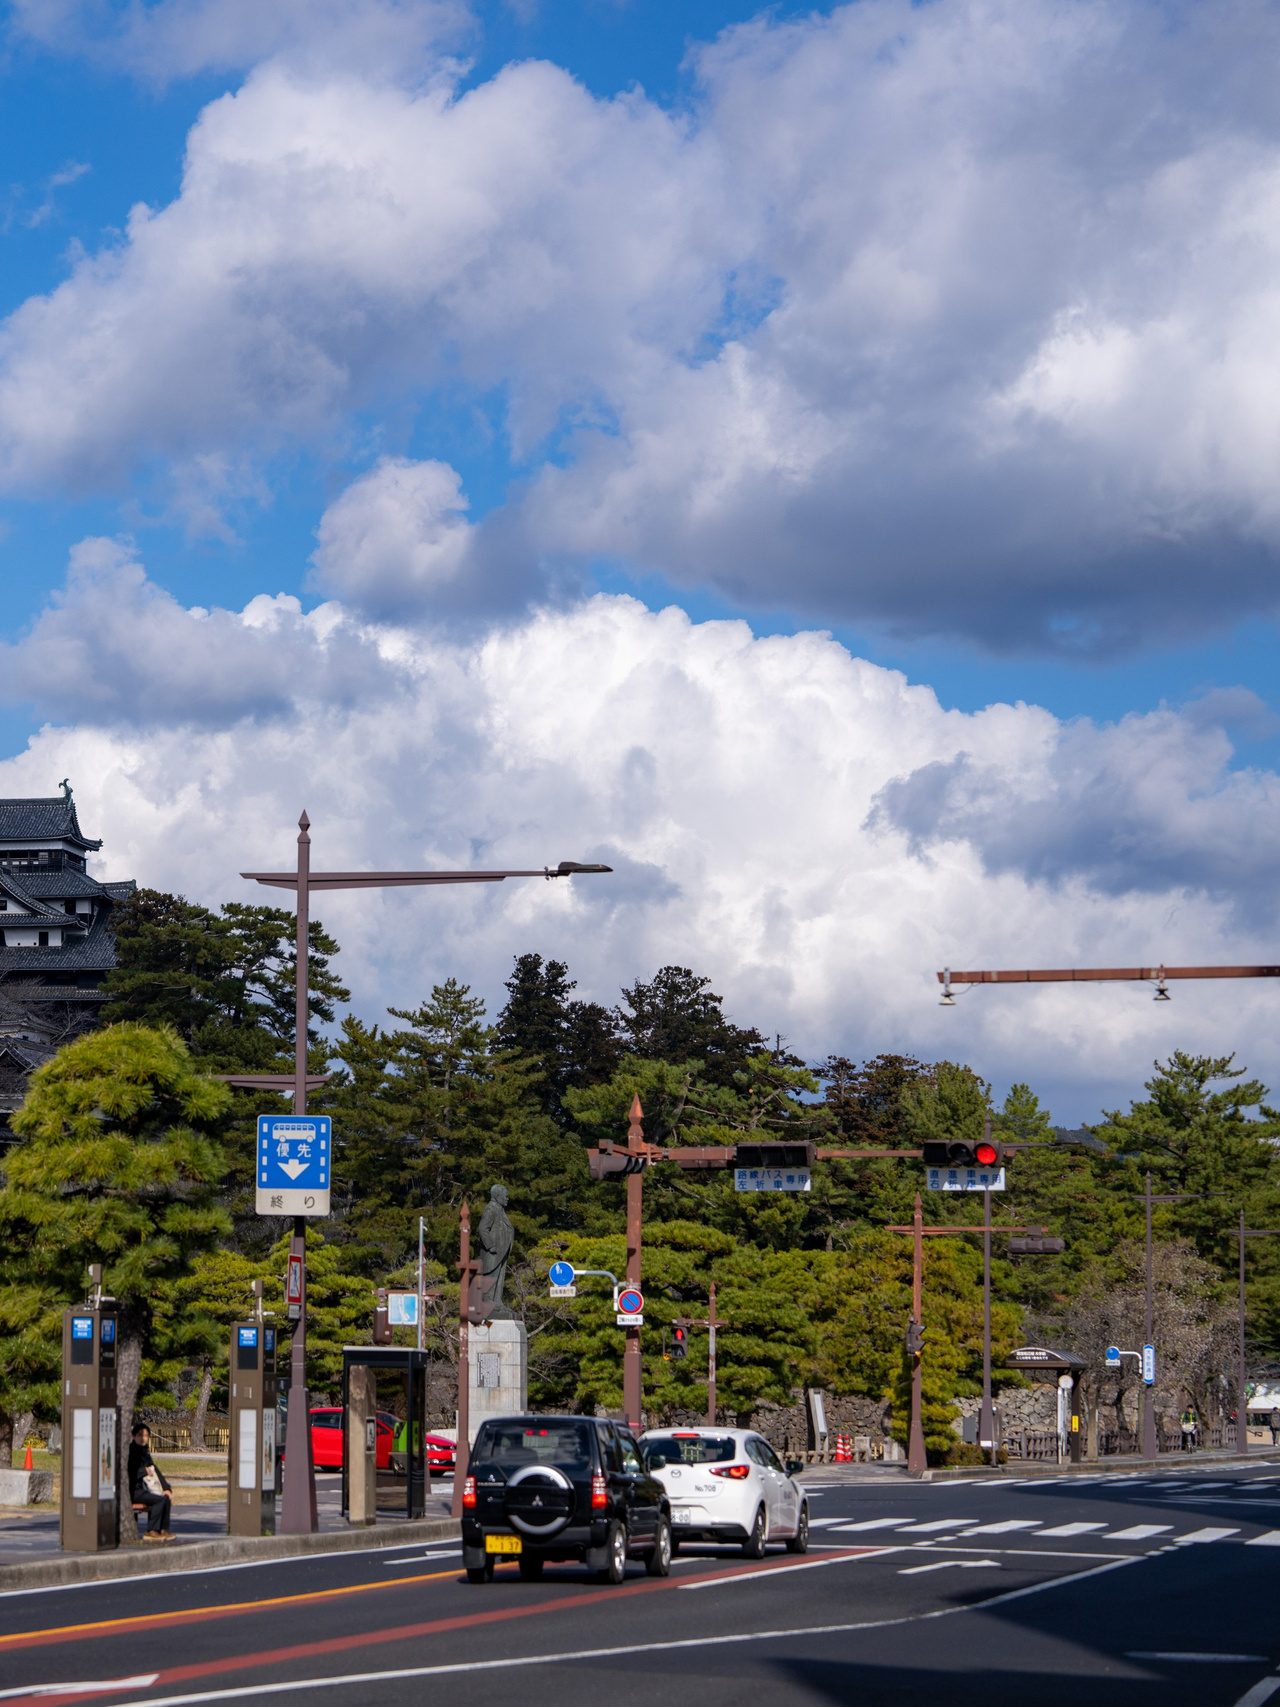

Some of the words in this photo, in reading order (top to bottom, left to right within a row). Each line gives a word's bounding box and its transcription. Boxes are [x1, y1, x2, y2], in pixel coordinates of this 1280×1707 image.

[276, 1142, 312, 1158] 優先
[737, 1169, 783, 1180] 路線バス
[737, 1180, 783, 1190] 左折車
[270, 1194, 316, 1209] 終り
